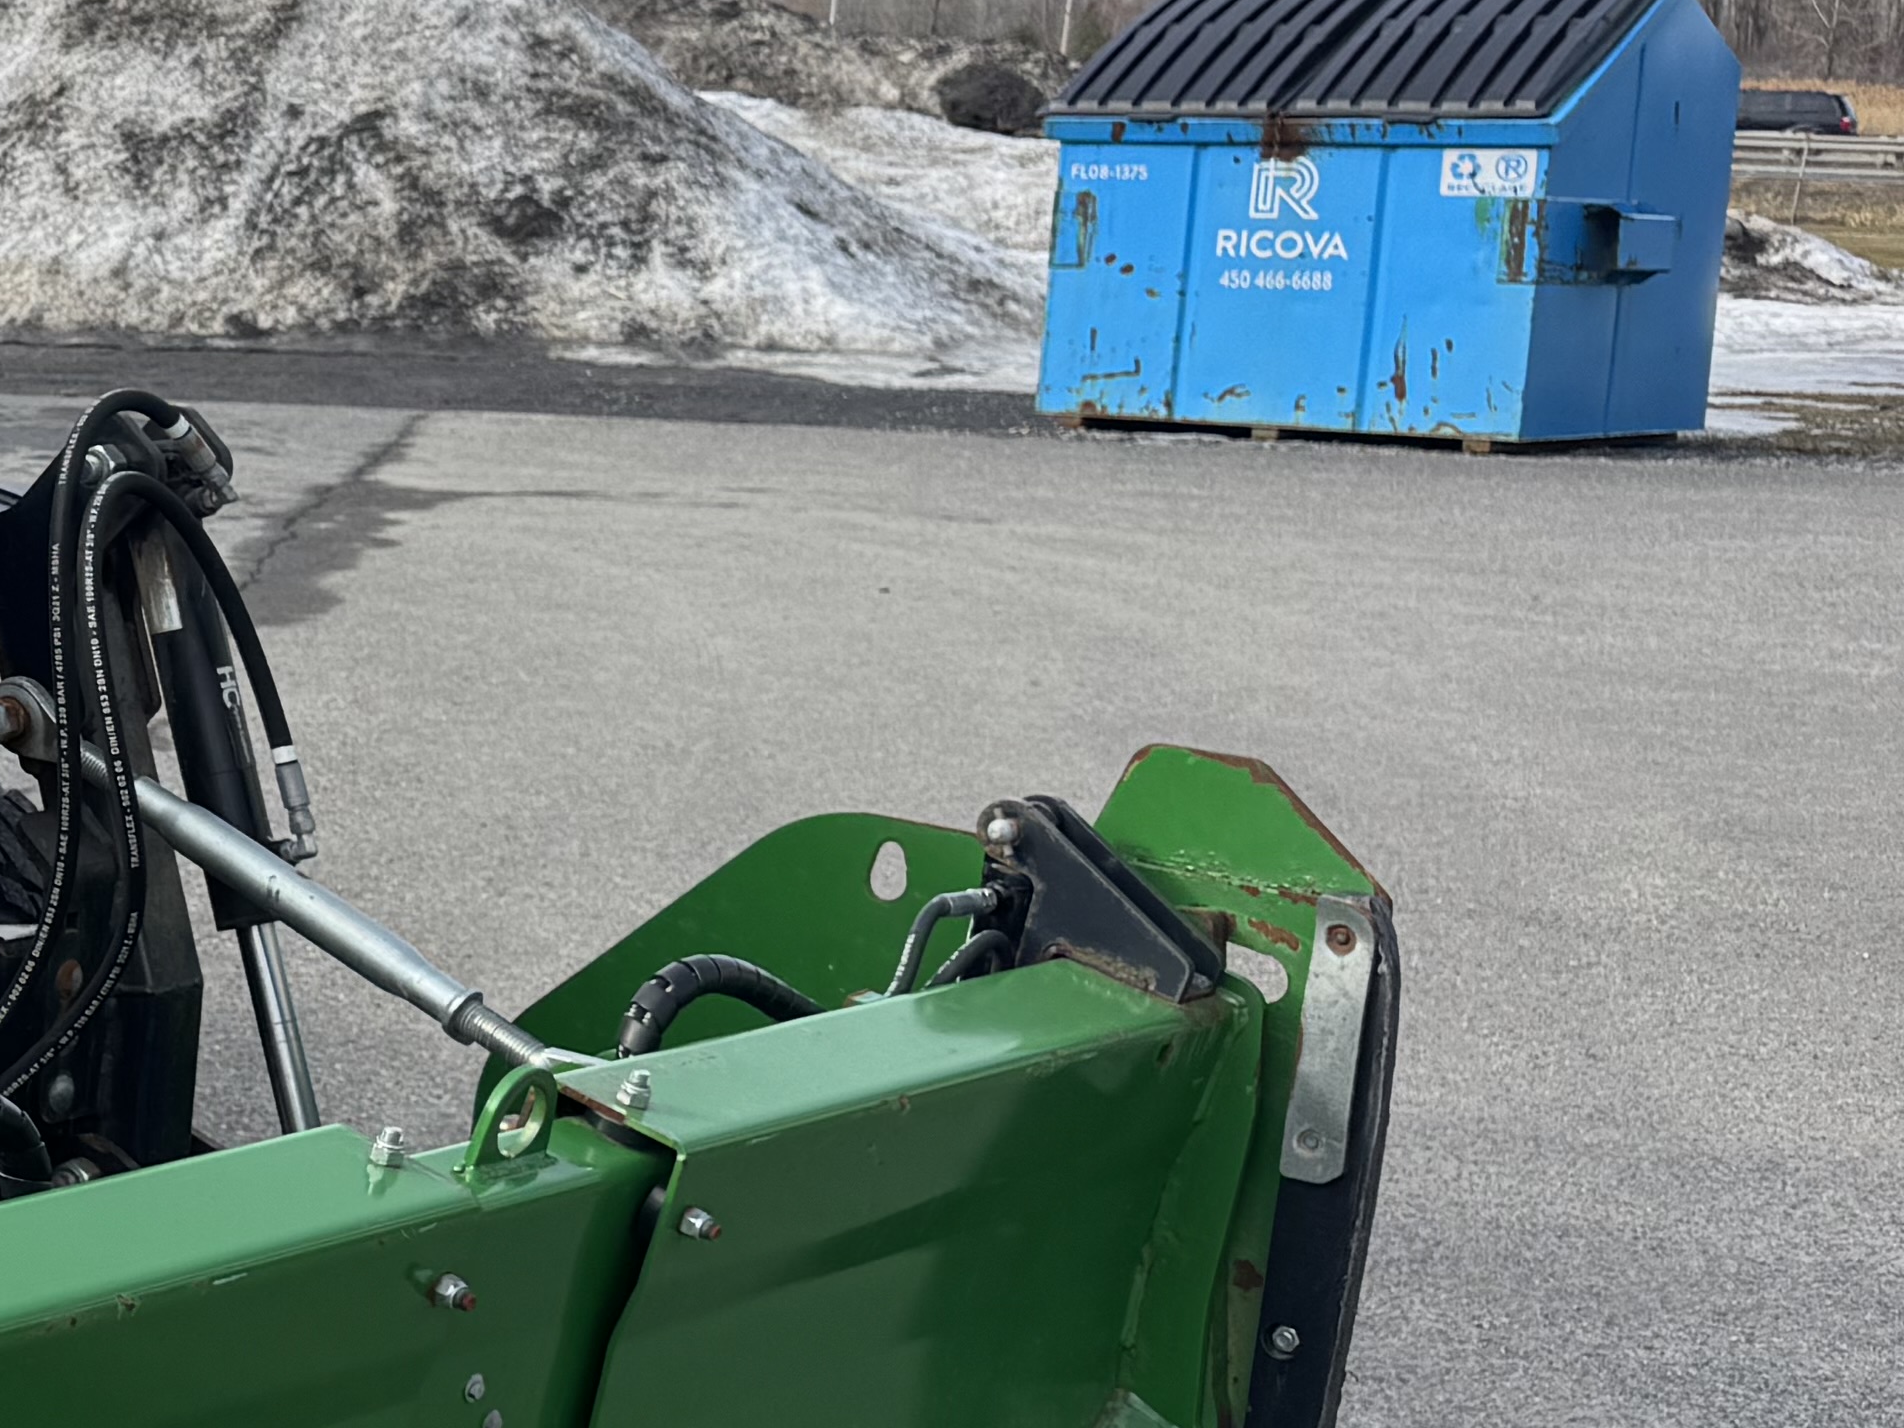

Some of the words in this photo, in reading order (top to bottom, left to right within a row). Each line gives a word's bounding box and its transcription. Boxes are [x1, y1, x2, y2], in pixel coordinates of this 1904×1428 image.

[1215, 228, 1348, 261] RICOVA
[1219, 271, 1250, 289] 450
[1254, 271, 1332, 291] 466-6688
[216, 665, 241, 709] HC
